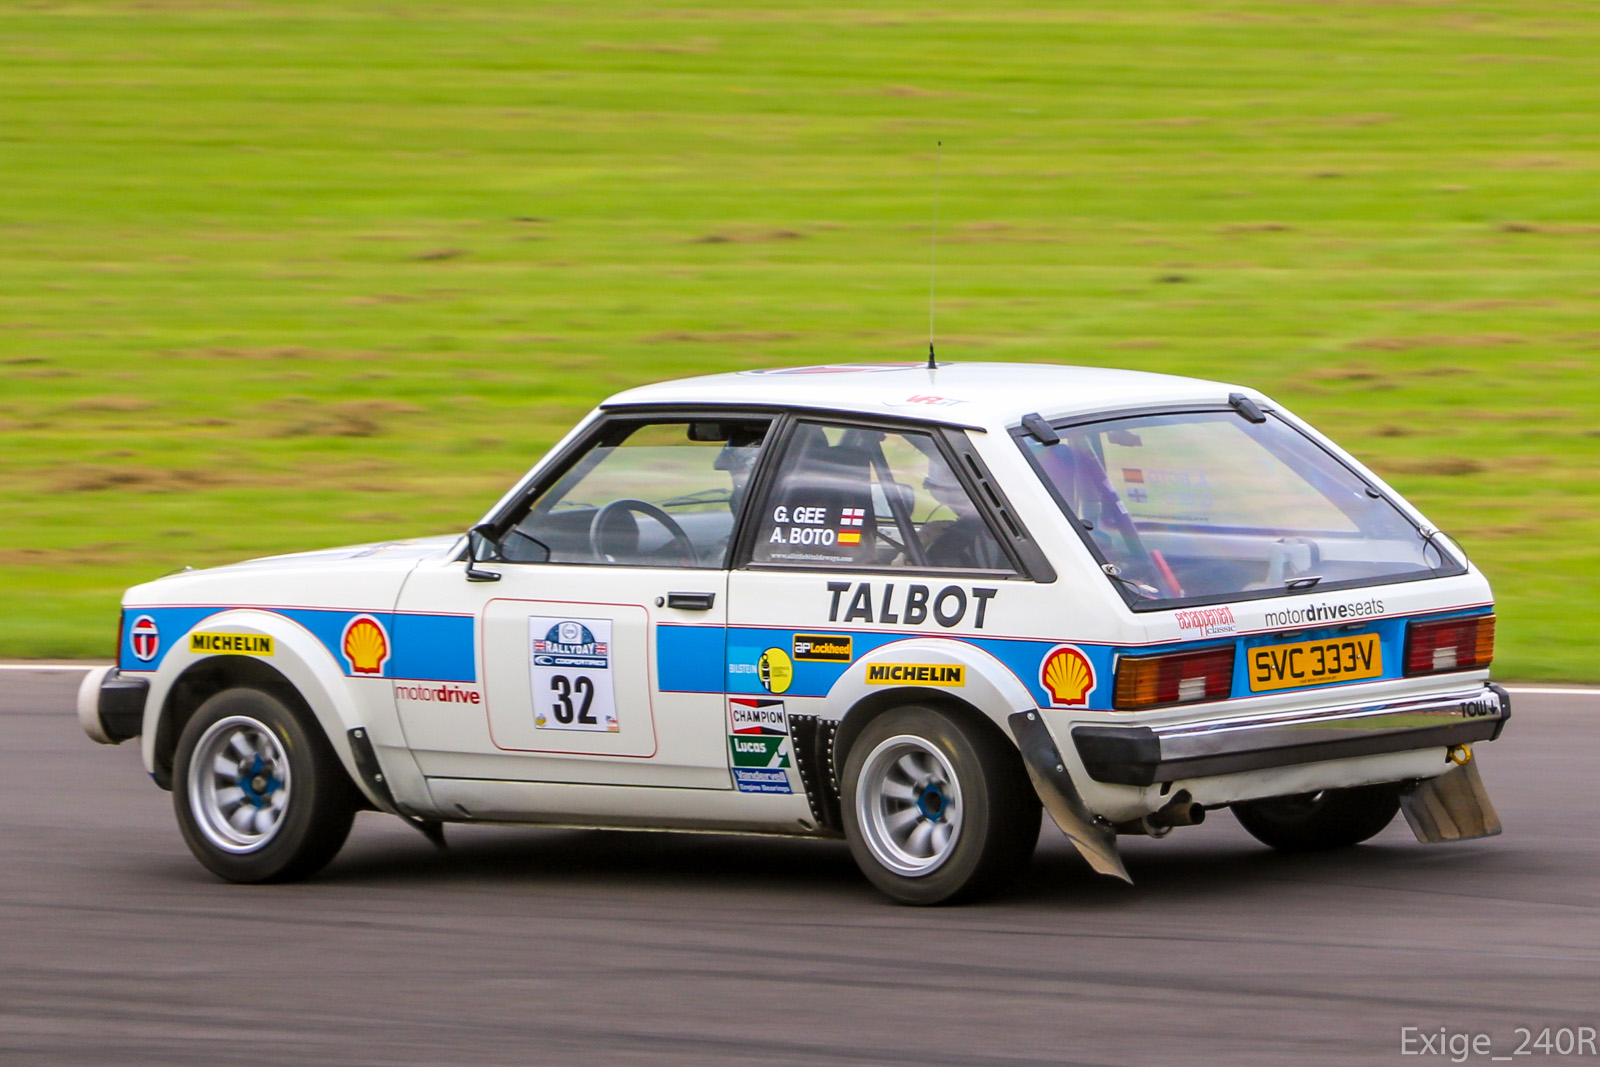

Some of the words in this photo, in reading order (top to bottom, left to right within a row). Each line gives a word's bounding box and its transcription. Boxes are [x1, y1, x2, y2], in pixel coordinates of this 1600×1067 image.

[773, 505, 790, 523] G.
[793, 506, 827, 524] GEE
[769, 526, 787, 544] A.
[789, 527, 834, 546] BOTO
[826, 581, 998, 629] TALBOT
[1265, 598, 1385, 627] motordriveseats
[1207, 624, 1236, 635] classic
[191, 635, 272, 654] MICHELIN
[545, 640, 596, 655] RALLYDAY
[810, 641, 850, 655] Lockheed
[729, 663, 757, 674] BILSTEIN
[1255, 647, 1305, 682] SVC
[1310, 639, 1374, 676] 333V
[868, 665, 961, 683] MICHELIN
[396, 684, 480, 704] motordrive
[551, 675, 598, 724] 32
[733, 709, 784, 724] CHAMPION
[1460, 701, 1487, 718] TOW
[734, 738, 767, 753] Lucas
